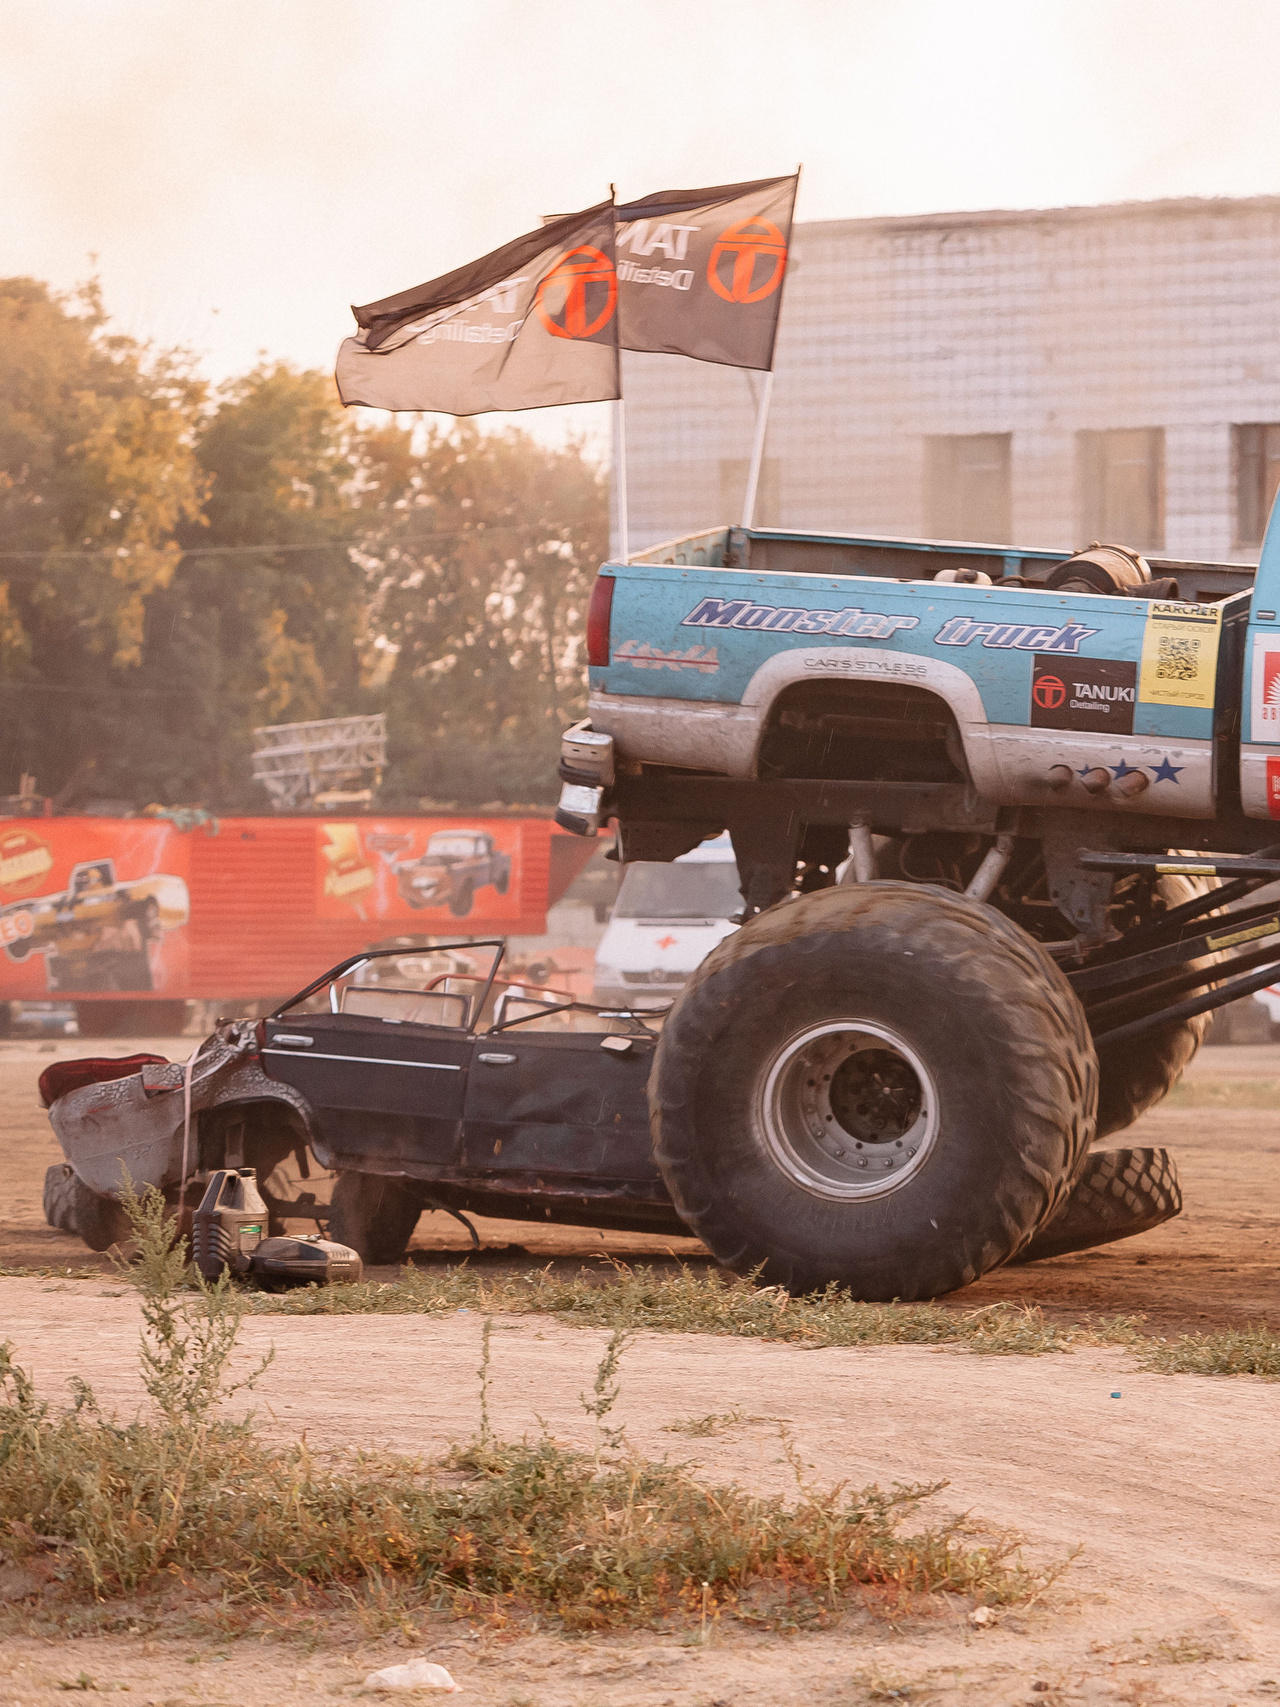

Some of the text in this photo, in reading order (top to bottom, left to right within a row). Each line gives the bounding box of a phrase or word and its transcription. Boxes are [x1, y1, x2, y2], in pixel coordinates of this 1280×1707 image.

[680, 597, 1102, 653] Monster truck
[1072, 682, 1135, 703] TANUKI
[1069, 699, 1110, 713] Detailing
